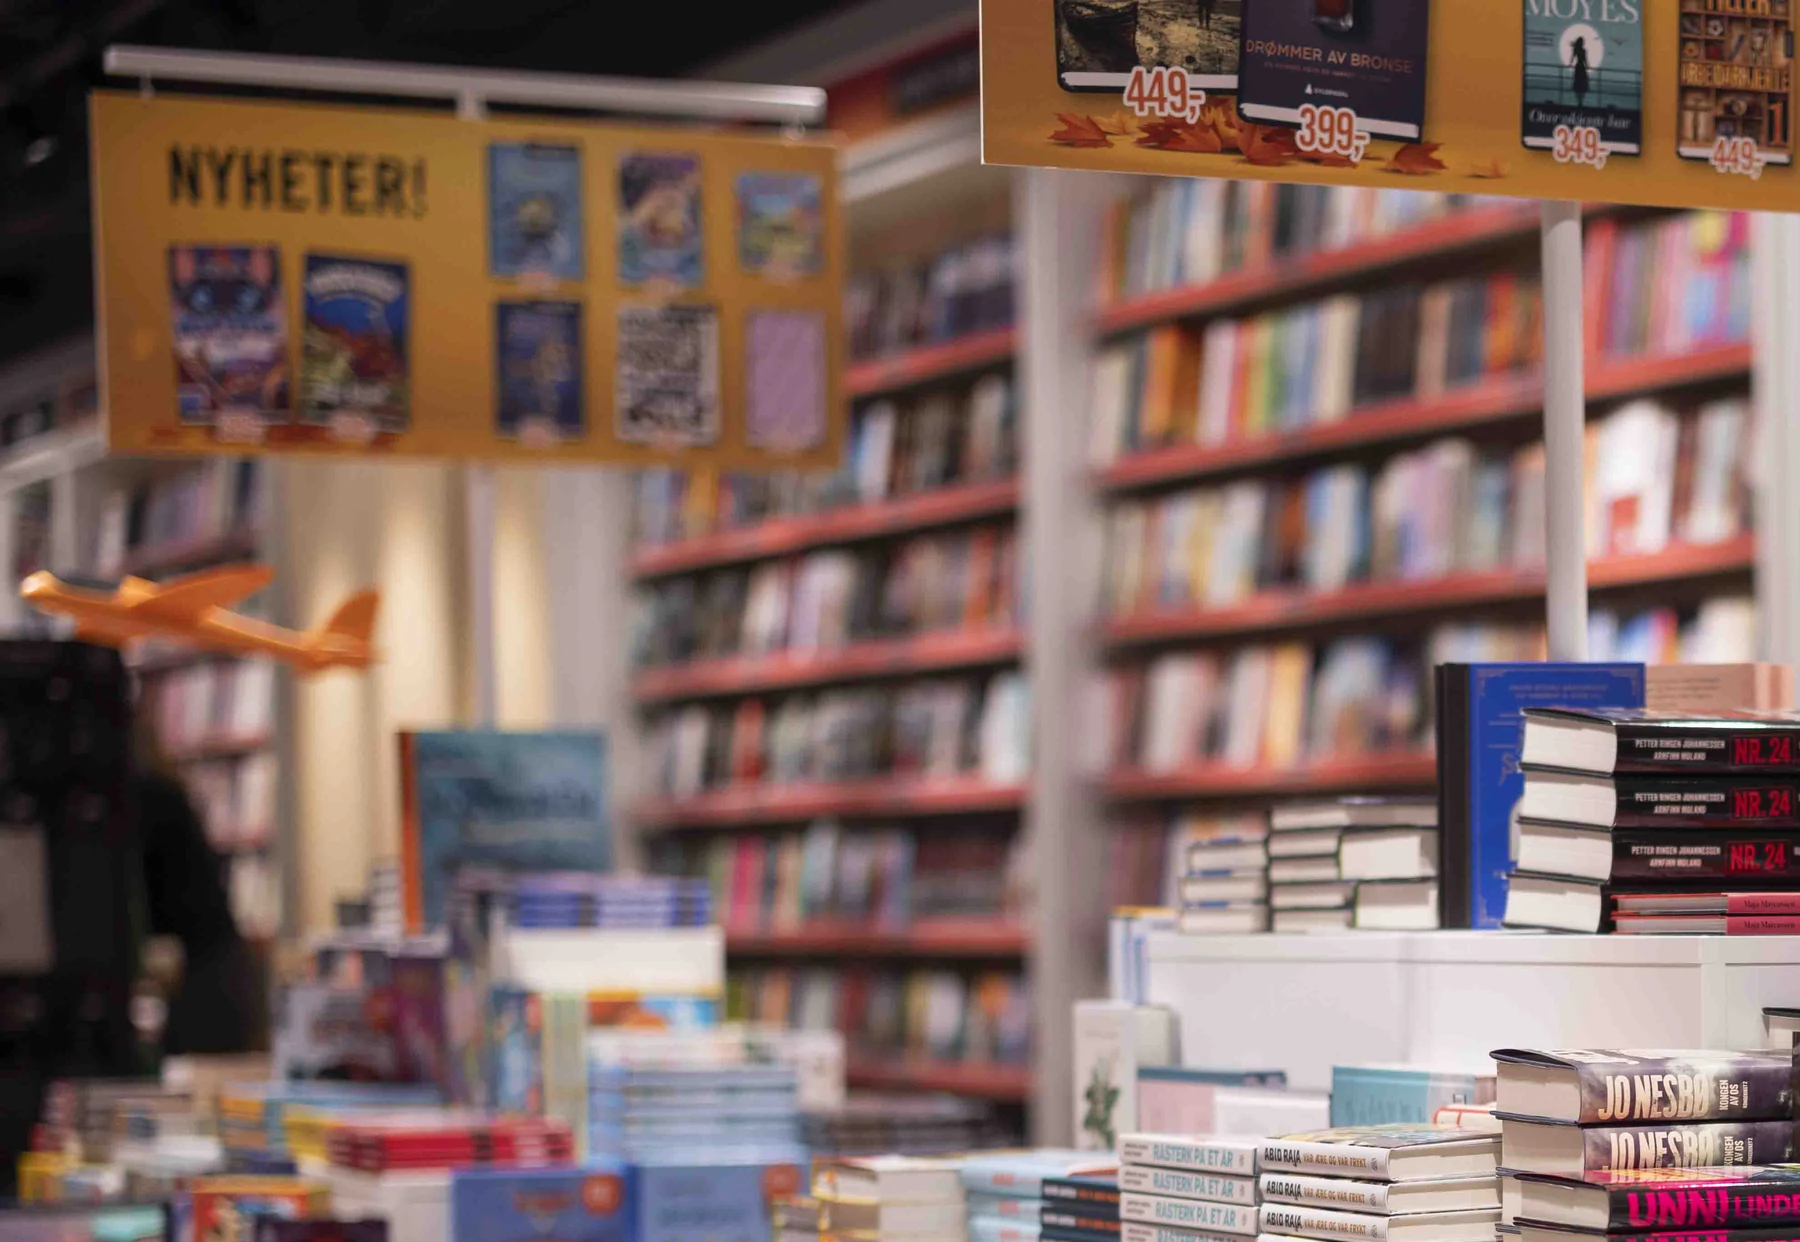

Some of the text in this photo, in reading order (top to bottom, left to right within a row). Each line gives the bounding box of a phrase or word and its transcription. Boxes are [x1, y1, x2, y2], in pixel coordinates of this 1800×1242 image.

[1246, 39, 1323, 62] DRØMMER
[1327, 51, 1347, 64] AV
[1351, 53, 1414, 73] BRONSE
[1126, 69, 1204, 121] 449,-
[1299, 106, 1368, 161] 399,-
[168, 144, 427, 221] NYHETER!
[1636, 739, 1658, 749] PETTER
[1735, 738, 1766, 765] NR.
[1770, 737, 1791, 764] 24
[1735, 792, 1766, 818] NR.
[1770, 790, 1791, 817] 24
[1598, 1073, 1711, 1120] JO NESBØ
[1719, 1080, 1729, 1111] KONGEN
[1730, 1083, 1739, 1106] AV OS
[1153, 1143, 1191, 1164] RÅSTERK
[1194, 1145, 1206, 1165] PÅ
[1208, 1152, 1219, 1167] ET
[1264, 1147, 1282, 1161] ABID
[1283, 1148, 1302, 1167] RAJA
[1626, 1189, 1730, 1227] UNNI
